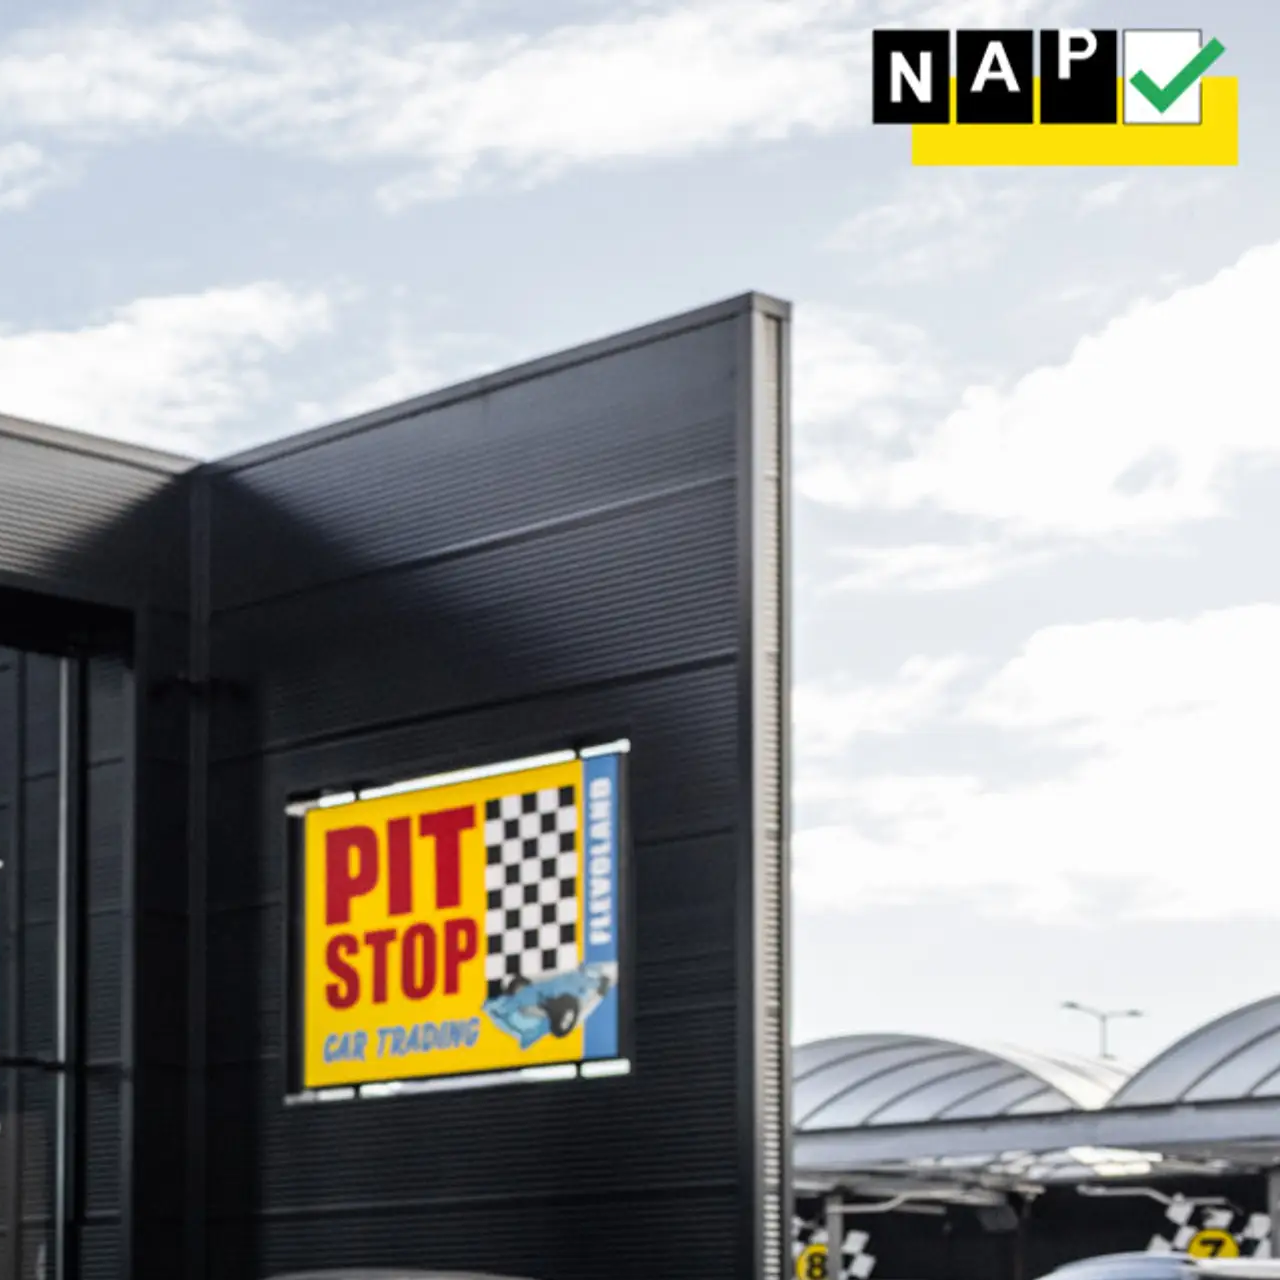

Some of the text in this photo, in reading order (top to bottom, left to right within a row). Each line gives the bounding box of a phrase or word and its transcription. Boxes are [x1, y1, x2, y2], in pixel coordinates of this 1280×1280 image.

[324, 804, 477, 926] PIT
[324, 917, 480, 1010] STOP
[322, 1016, 481, 1064] CAR TRADING
